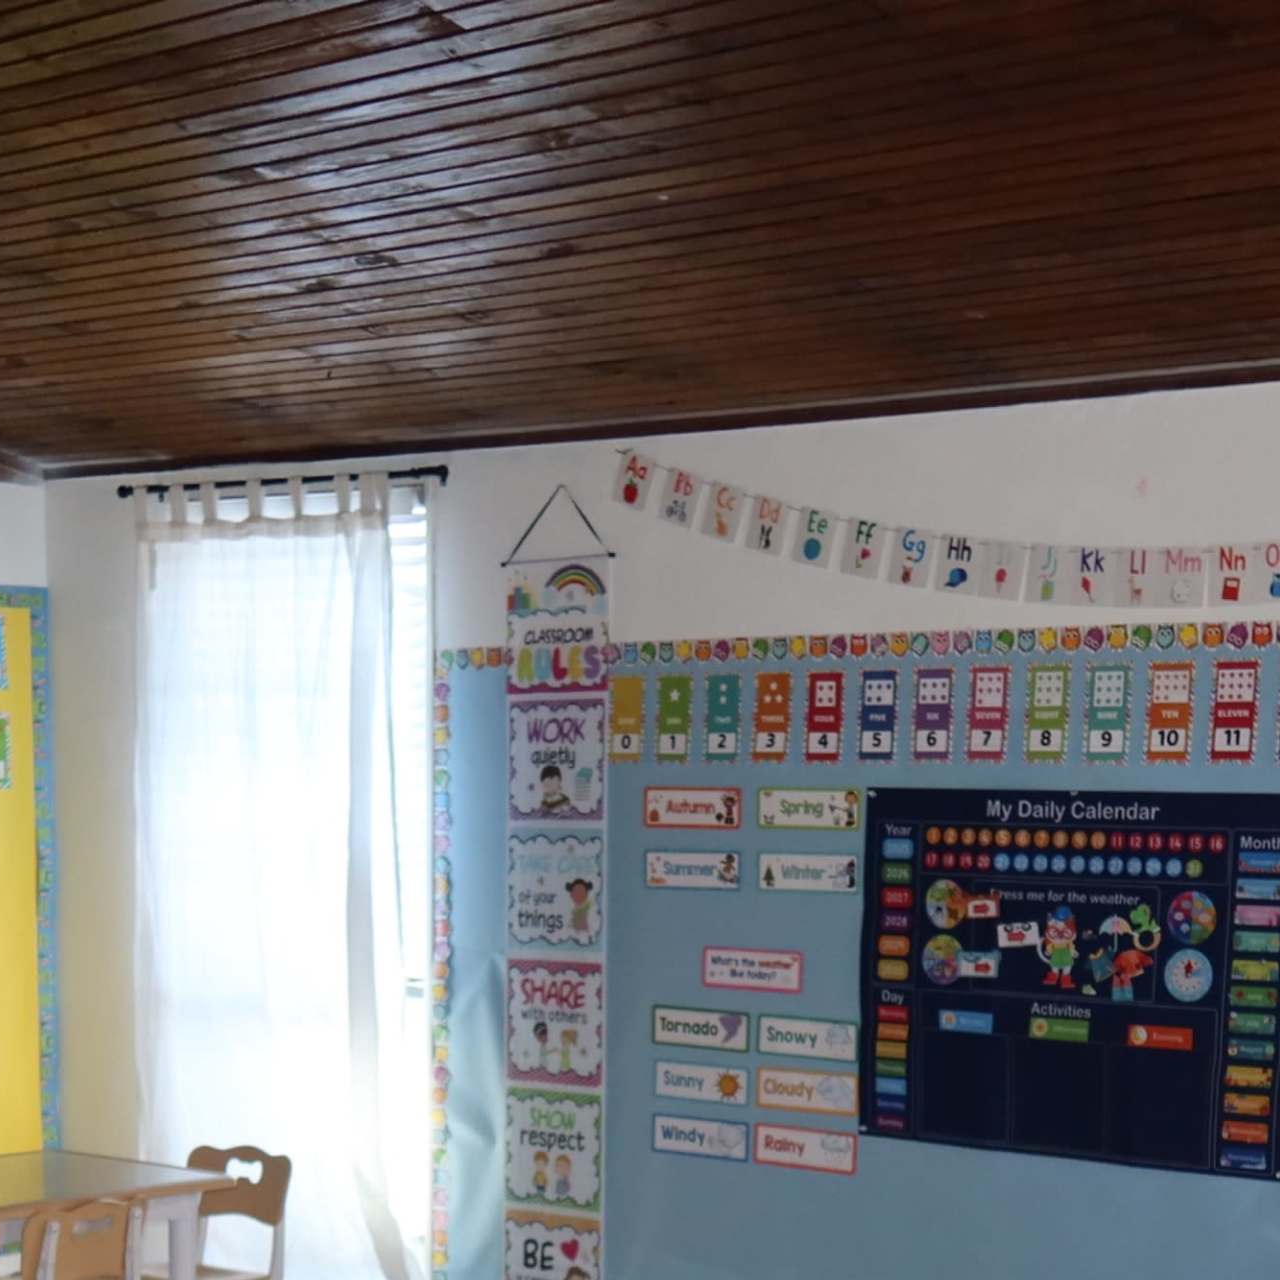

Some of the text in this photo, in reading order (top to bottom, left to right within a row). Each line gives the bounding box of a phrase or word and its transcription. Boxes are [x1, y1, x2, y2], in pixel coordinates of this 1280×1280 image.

[807, 510, 828, 534] Ee
[856, 520, 877, 545] Ff
[902, 529, 926, 562] Gg
[947, 536, 972, 562] Hh
[1080, 547, 1104, 573] Kk
[1130, 549, 1146, 575] Ll
[1165, 548, 1201, 574] Mm
[1219, 547, 1246, 572] Nn
[523, 626, 594, 645] CLASSROOM
[516, 645, 601, 682] RULES
[1217, 709, 1249, 718] ELEVEN
[526, 716, 586, 745] WORK
[872, 732, 882, 747] 5
[926, 731, 937, 746] 6
[982, 730, 991, 746] 7
[1040, 730, 1051, 746] 8
[1102, 730, 1112, 747] 9
[1158, 729, 1179, 746] 10
[1224, 729, 1241, 746] 11
[621, 735, 631, 749] 0
[670, 735, 676, 749] 1
[717, 733, 727, 748] 2
[766, 733, 776, 748] 3
[818, 733, 828, 748] 4
[530, 745, 576, 769] quietly
[666, 799, 715, 814] Autumn
[780, 799, 824, 817] Spring
[986, 799, 1160, 823] My Daily Calendar
[885, 823, 912, 836] Year
[663, 862, 717, 876] Summer
[780, 864, 825, 880] Winter
[1047, 889, 1064, 902] for
[1068, 890, 1087, 903] the
[1090, 892, 1139, 906] weather
[518, 909, 564, 934] things
[711, 955, 792, 969] What's the weather
[730, 968, 777, 981] like today?
[521, 977, 587, 1010] SHARE
[881, 989, 904, 1005] Day
[1030, 1002, 1091, 1018] Activities
[659, 1017, 718, 1036] Tornado
[767, 1026, 817, 1047] Snowy
[663, 1070, 704, 1090] Sunny
[763, 1078, 814, 1101] Cloudy
[528, 1106, 576, 1132] SHOW
[520, 1128, 586, 1152] respect
[661, 1125, 705, 1146] Windy
[764, 1135, 805, 1156] Rainy
[523, 1238, 555, 1271] BE
